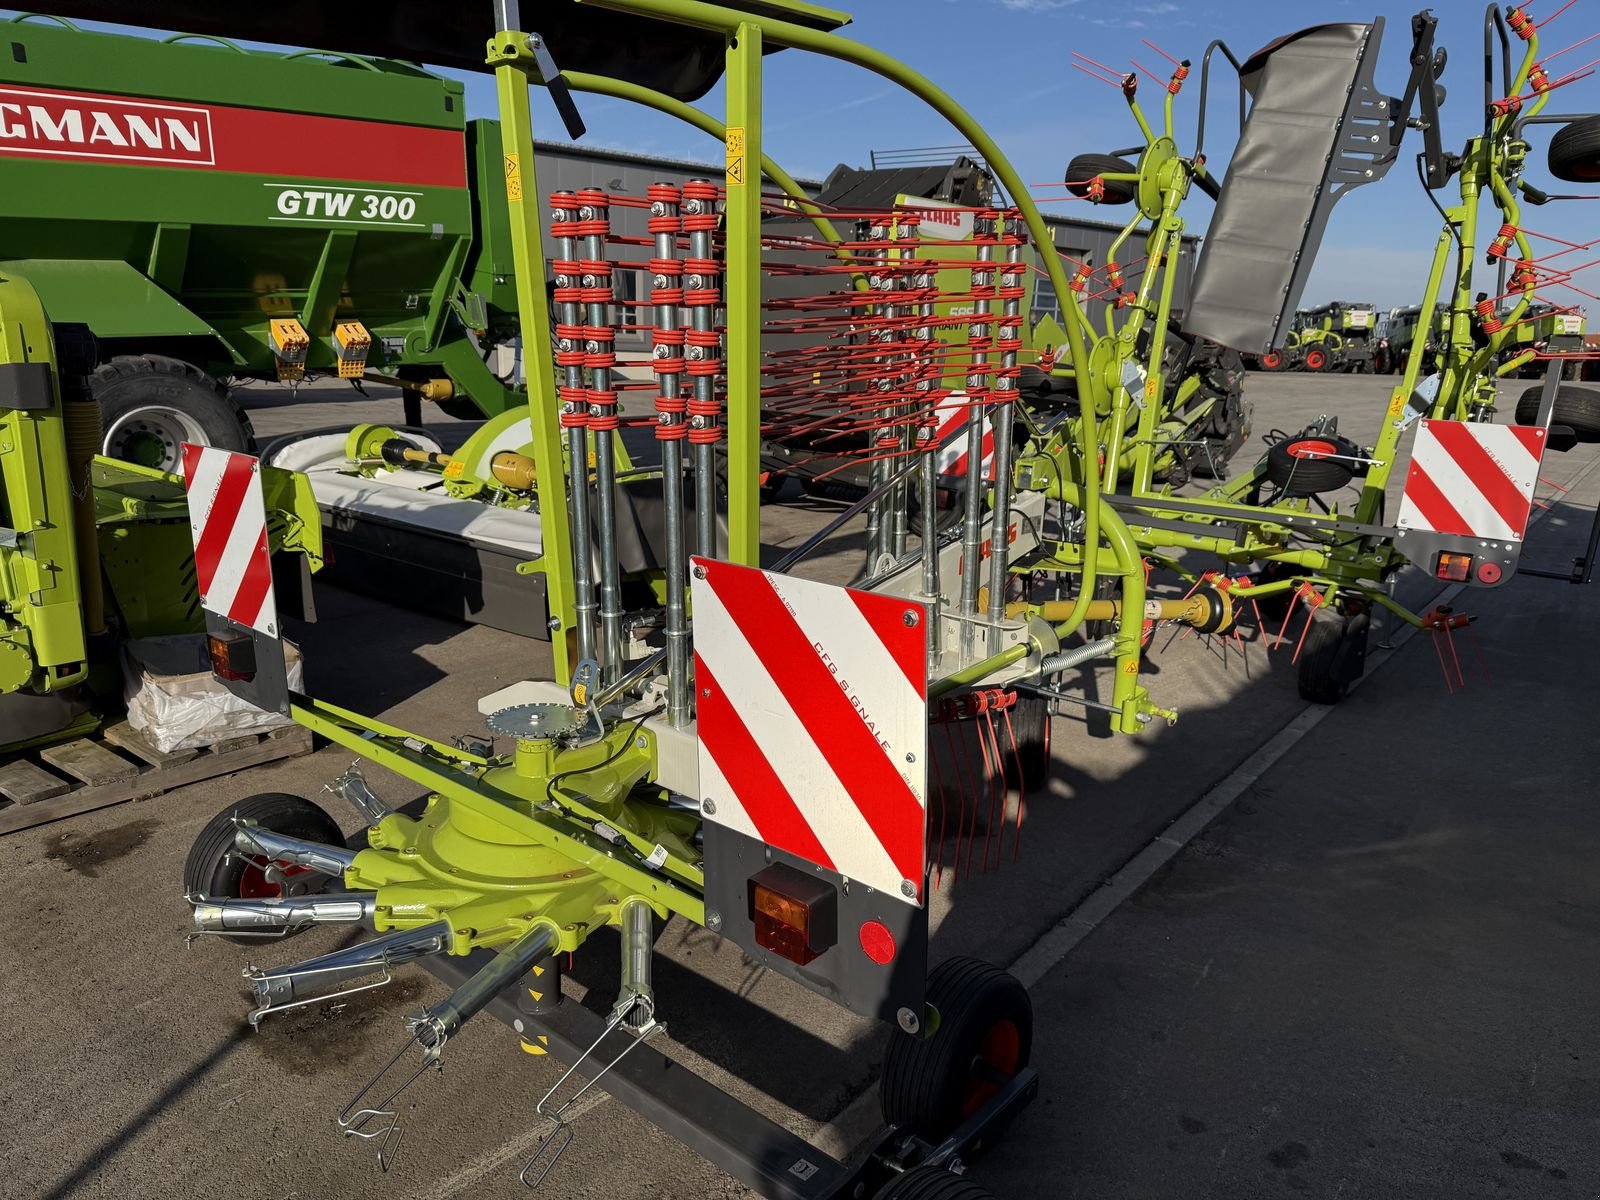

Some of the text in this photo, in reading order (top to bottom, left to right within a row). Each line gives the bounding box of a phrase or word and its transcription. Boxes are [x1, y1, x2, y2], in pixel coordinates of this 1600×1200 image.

[0, 102, 201, 153] GMANN
[277, 190, 416, 221] GTW 300
[814, 641, 891, 753] CFG SIGNALE
